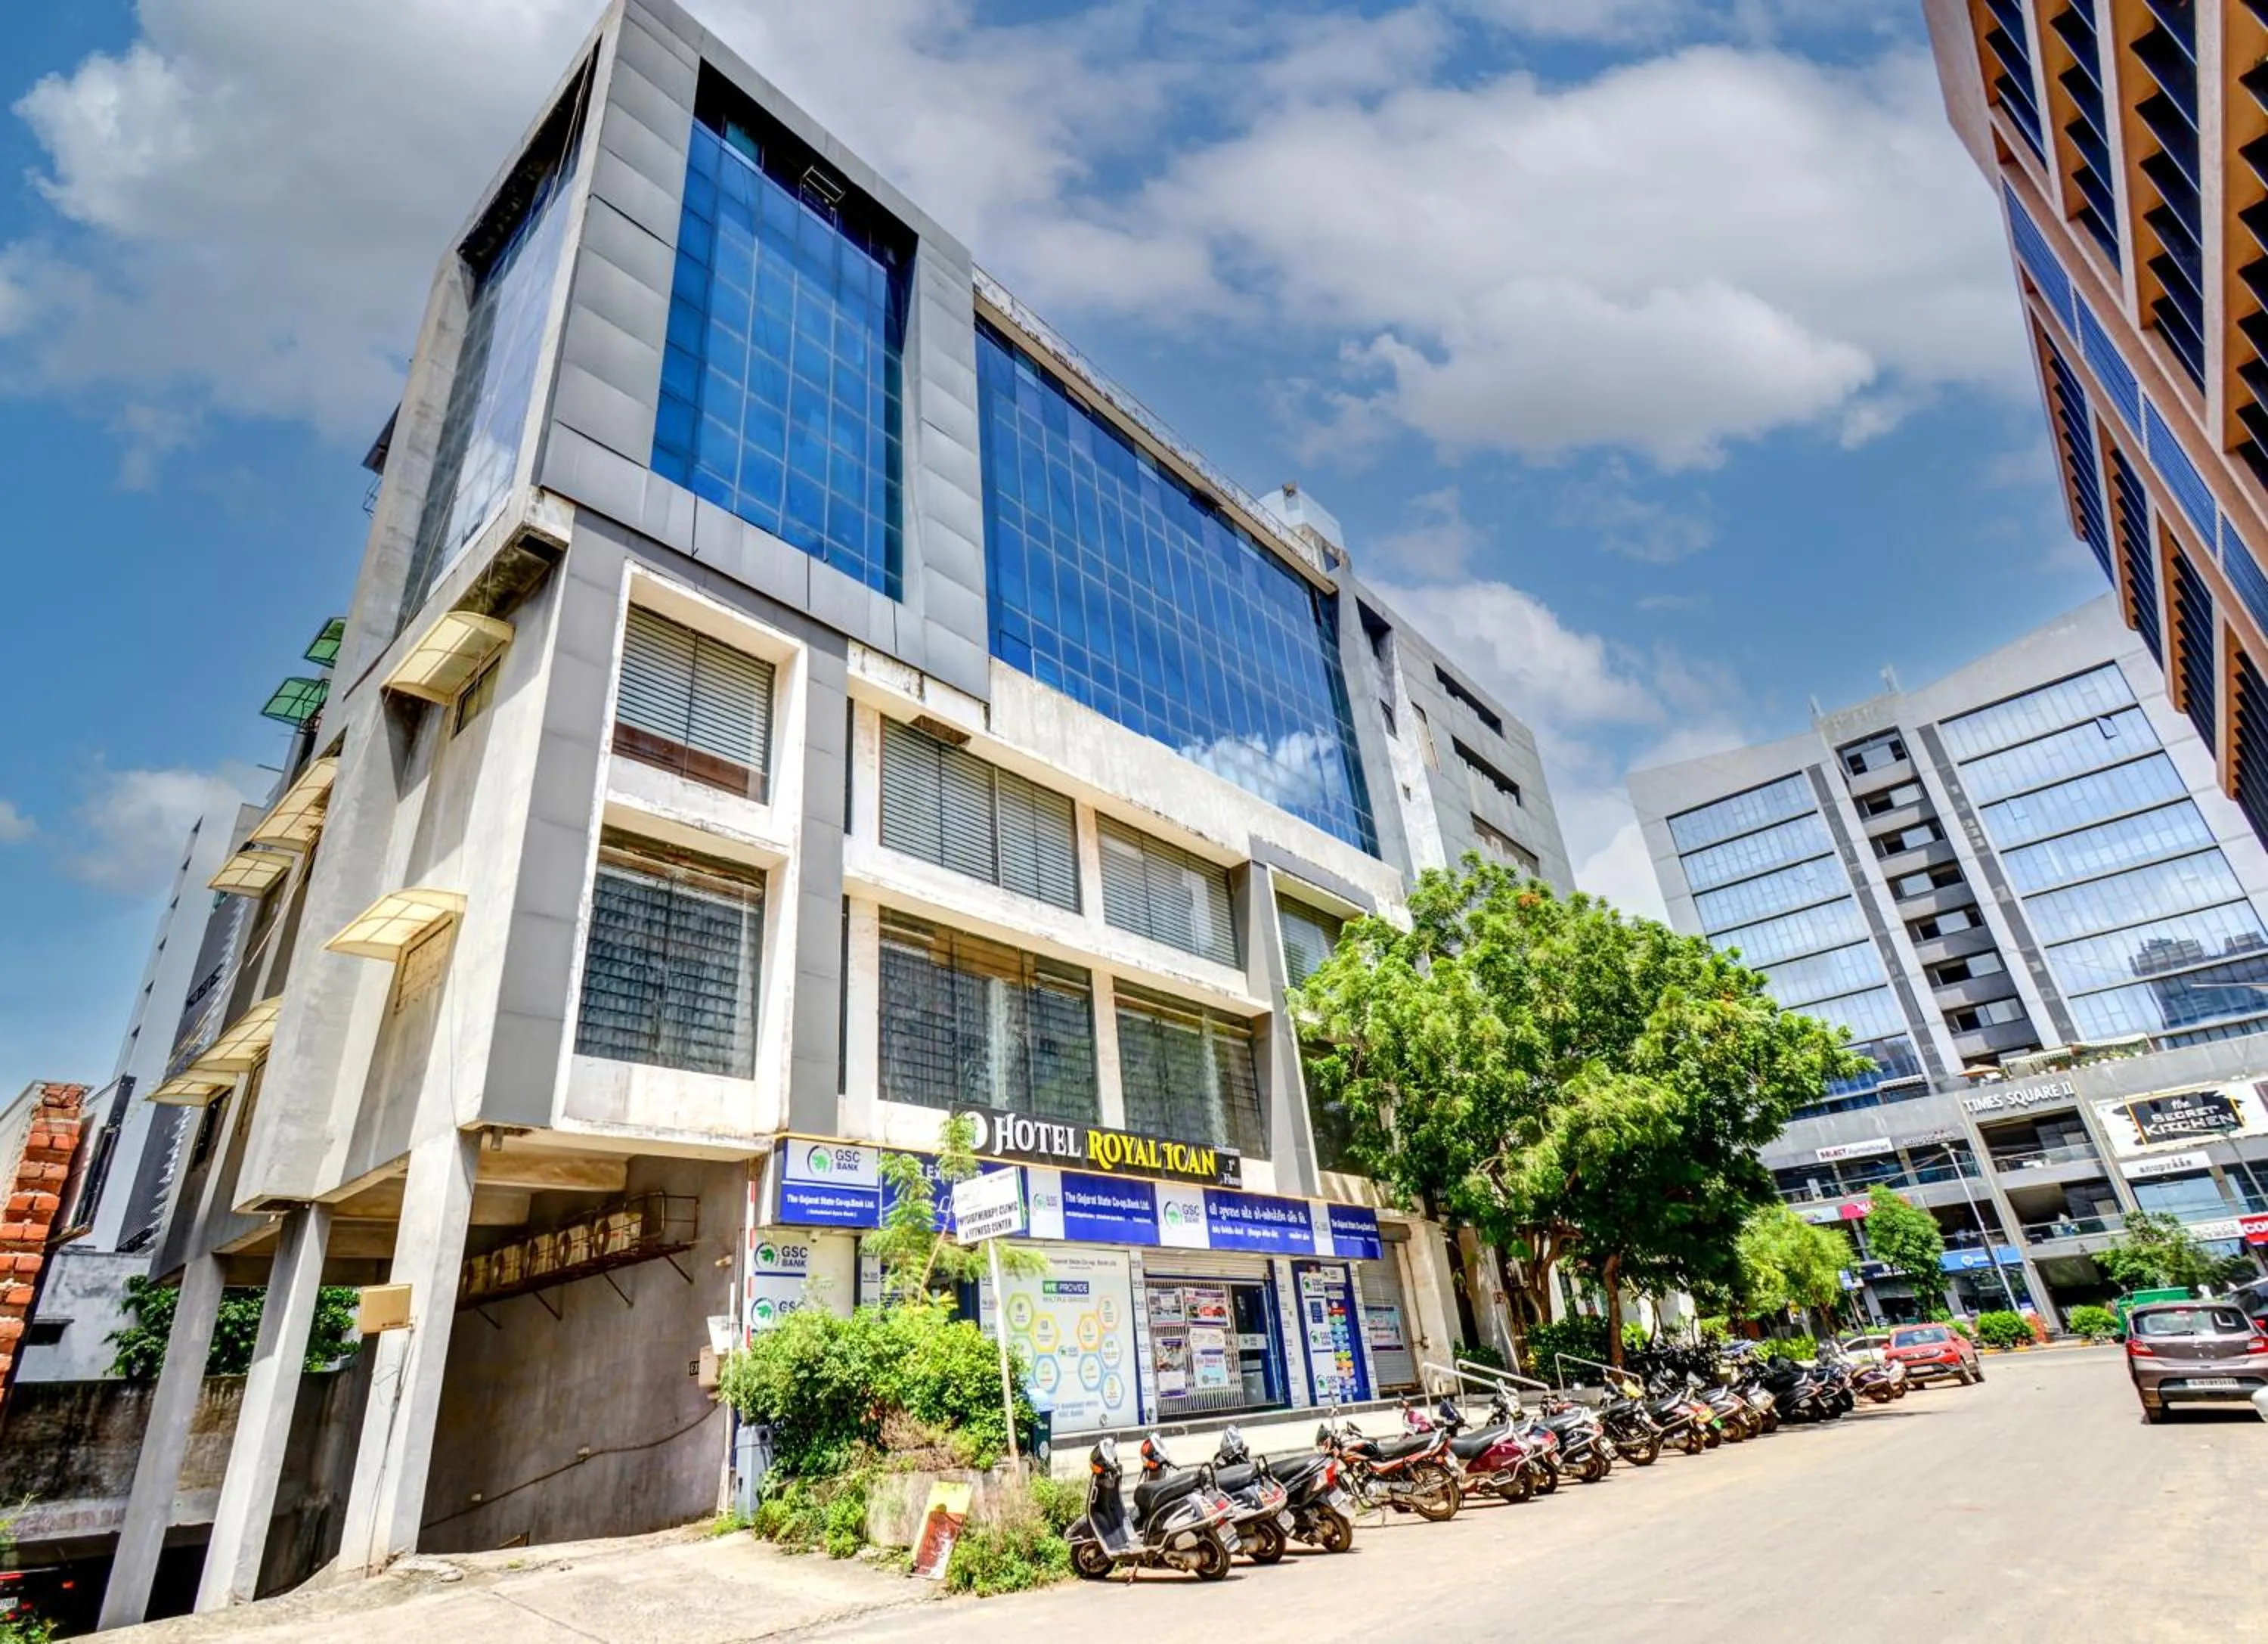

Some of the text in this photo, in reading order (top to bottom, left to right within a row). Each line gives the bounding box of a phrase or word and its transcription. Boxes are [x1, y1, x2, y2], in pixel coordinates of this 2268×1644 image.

[1963, 1093, 2003, 1112] TIMES
[2007, 1084, 2060, 1106] SQUARE
[2171, 1099, 2192, 1109] the
[2151, 1105, 2220, 1123] SECRET
[2143, 1112, 2237, 1136] KITCHEN
[992, 1113, 1082, 1157] HOTEL
[1087, 1129, 1160, 1170] ROYAL
[835, 1149, 860, 1163] GSC
[1820, 1148, 1846, 1159] SELECT
[836, 1162, 859, 1171] BANK
[786, 1194, 798, 1203] The
[800, 1194, 819, 1206] Gujarat
[821, 1196, 834, 1205] State
[1064, 1191, 1076, 1203] The
[1077, 1193, 1096, 1207] Gujarat
[1097, 1195, 1111, 1206] State
[999, 1201, 1018, 1216] CLINIC
[1182, 1204, 1200, 1216] GSC
[992, 1217, 1012, 1233] CENTER
[782, 1245, 808, 1258] GSC
[782, 1258, 807, 1267] BANK
[1044, 1282, 1088, 1292] WE PROVIDE
